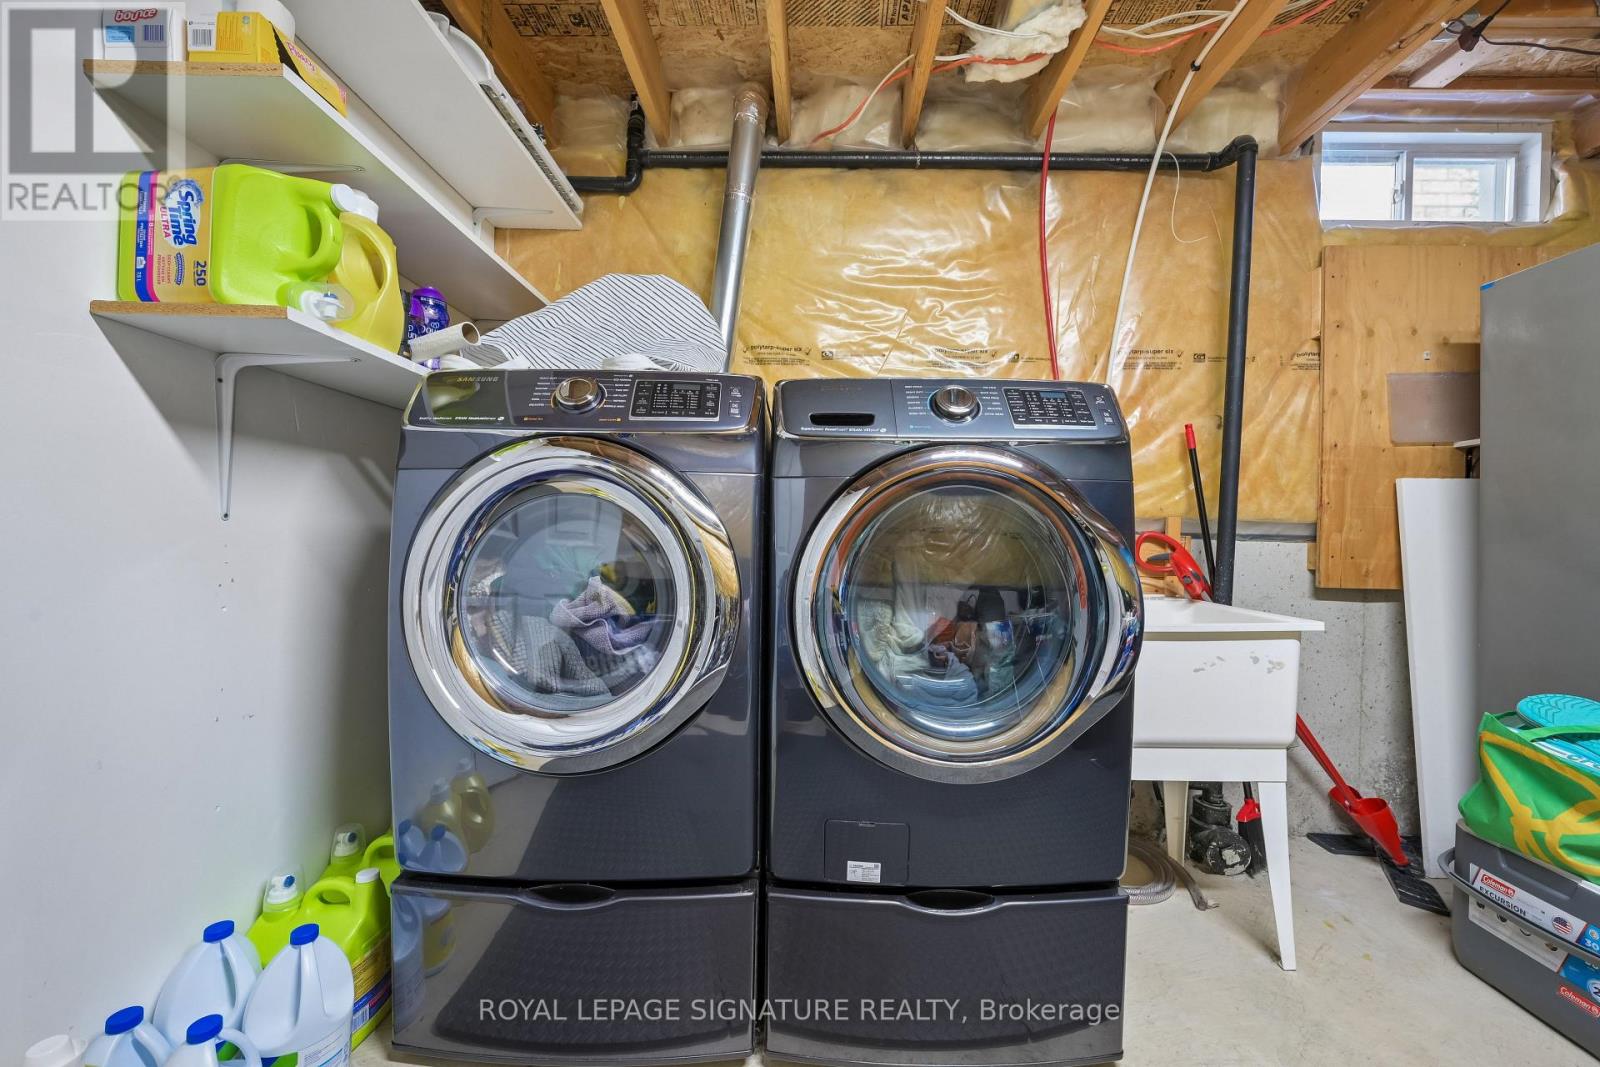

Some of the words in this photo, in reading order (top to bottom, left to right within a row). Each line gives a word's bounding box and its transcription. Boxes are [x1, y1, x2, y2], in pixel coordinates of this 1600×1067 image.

[115, 8, 157, 22] bounce
[159, 206, 171, 239] ULTRA
[168, 205, 184, 246] Time
[176, 190, 198, 246] Spring
[195, 260, 207, 287] 250
[1482, 875, 1509, 894] Coleman
[1479, 885, 1527, 917] EXCURSION
[1560, 985, 1591, 1011] Coleman
